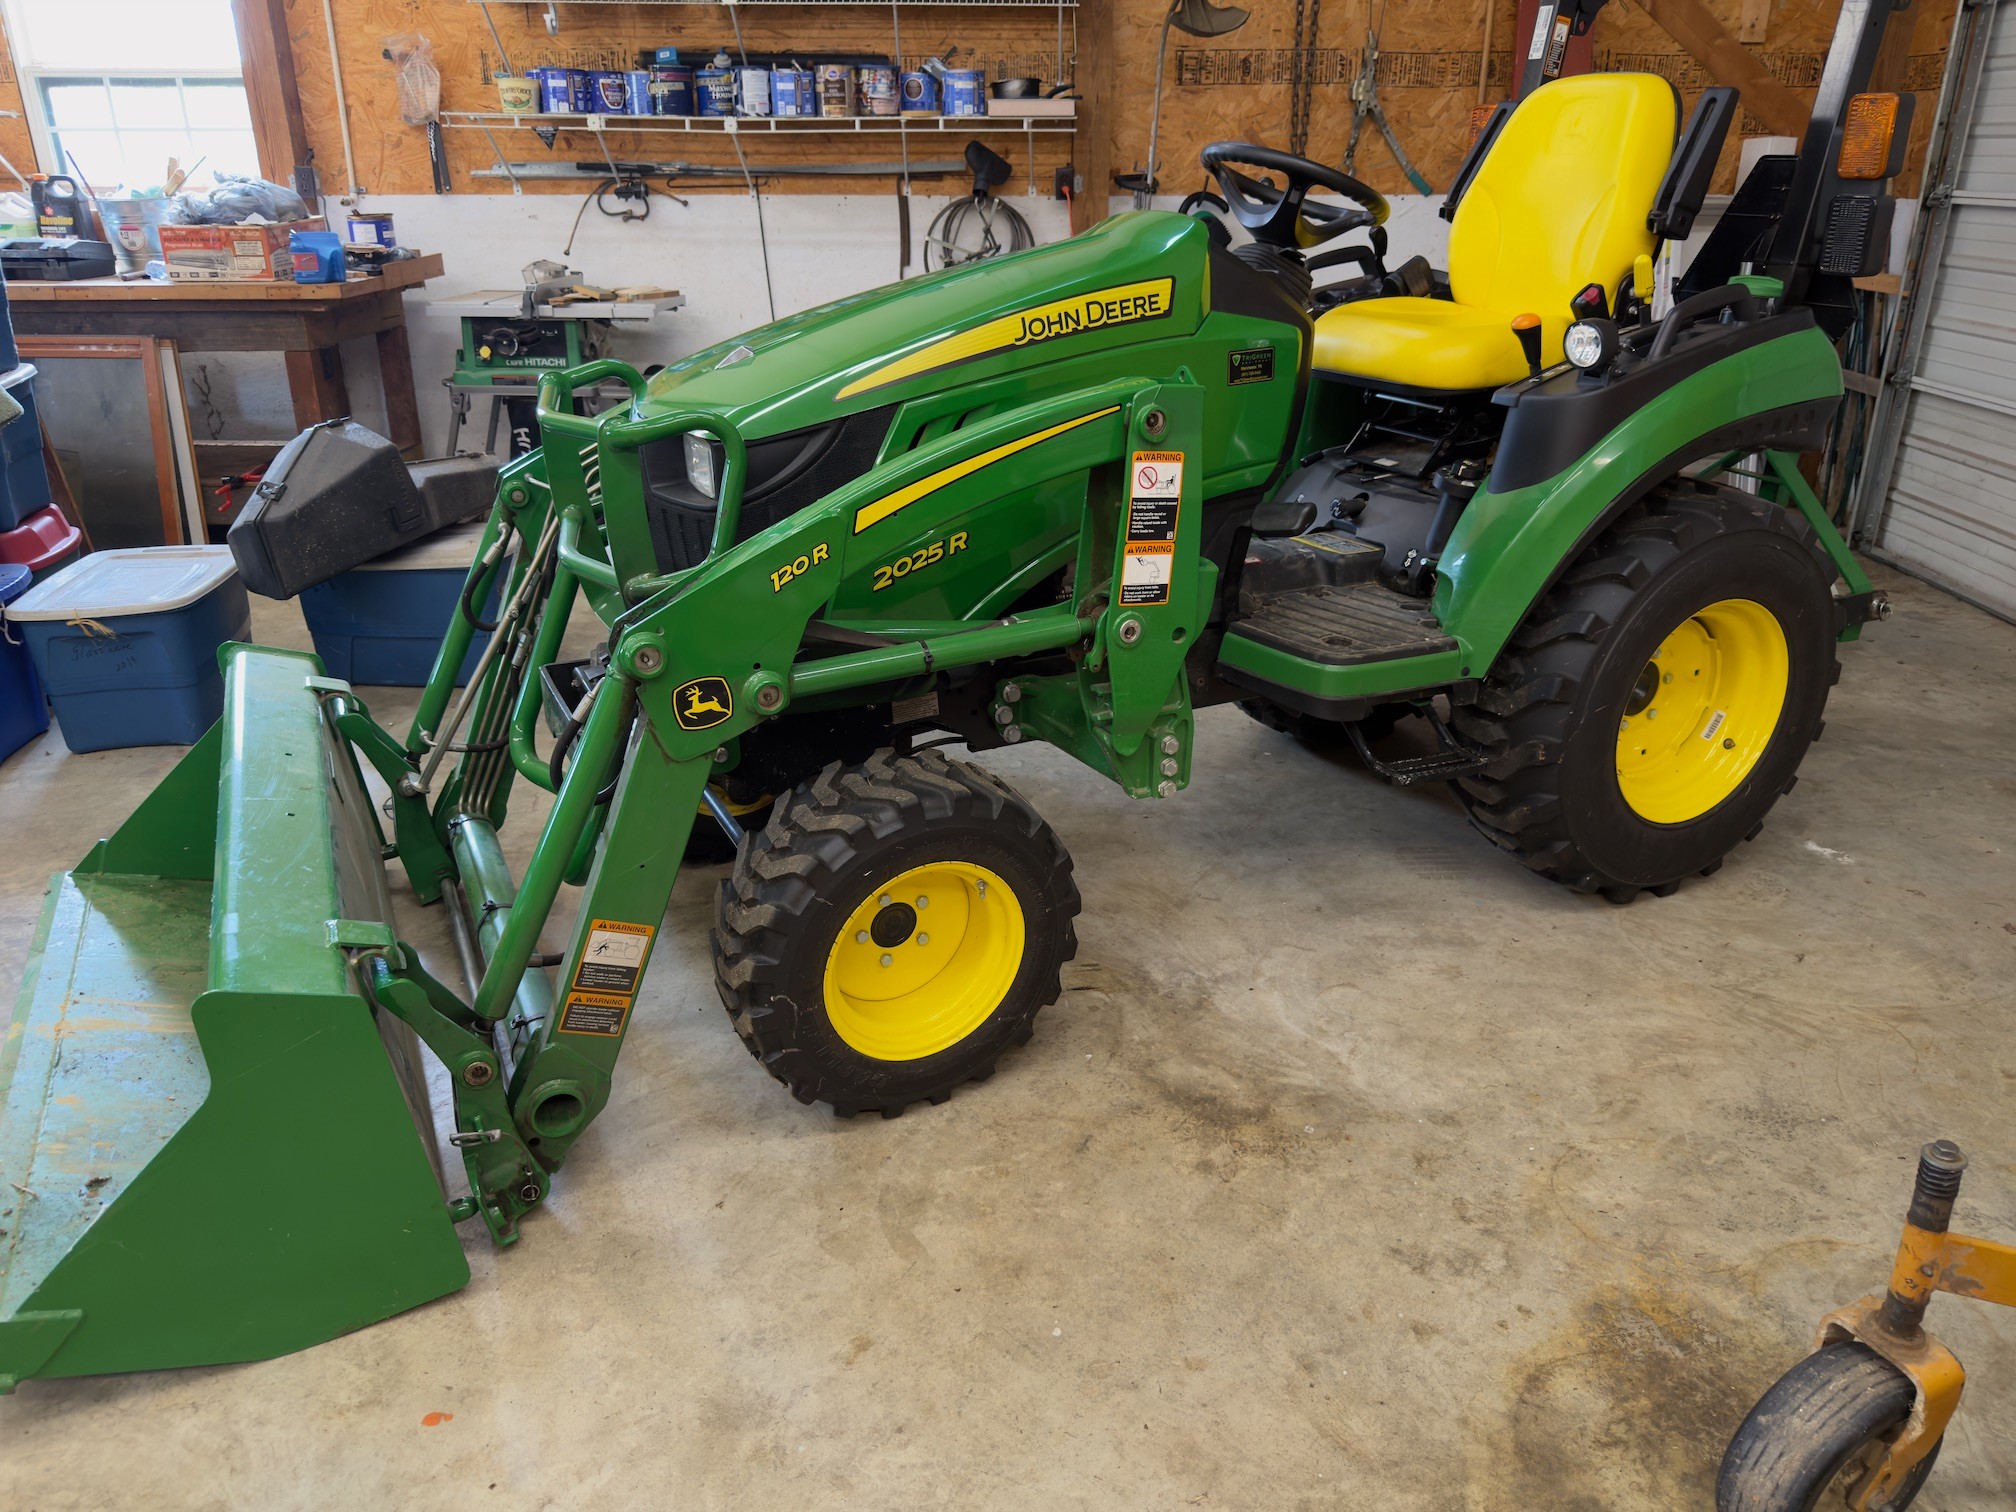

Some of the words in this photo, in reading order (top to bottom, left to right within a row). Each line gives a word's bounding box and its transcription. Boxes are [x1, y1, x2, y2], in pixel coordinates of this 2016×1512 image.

[1014, 307, 1082, 343] JOHN
[1085, 293, 1161, 325] DEERE
[524, 358, 566, 367] HITACHI
[1143, 453, 1182, 461] WARNING
[1135, 545, 1172, 553] WARNING
[609, 922, 647, 934] WARNING
[586, 997, 624, 1006] WARNING
